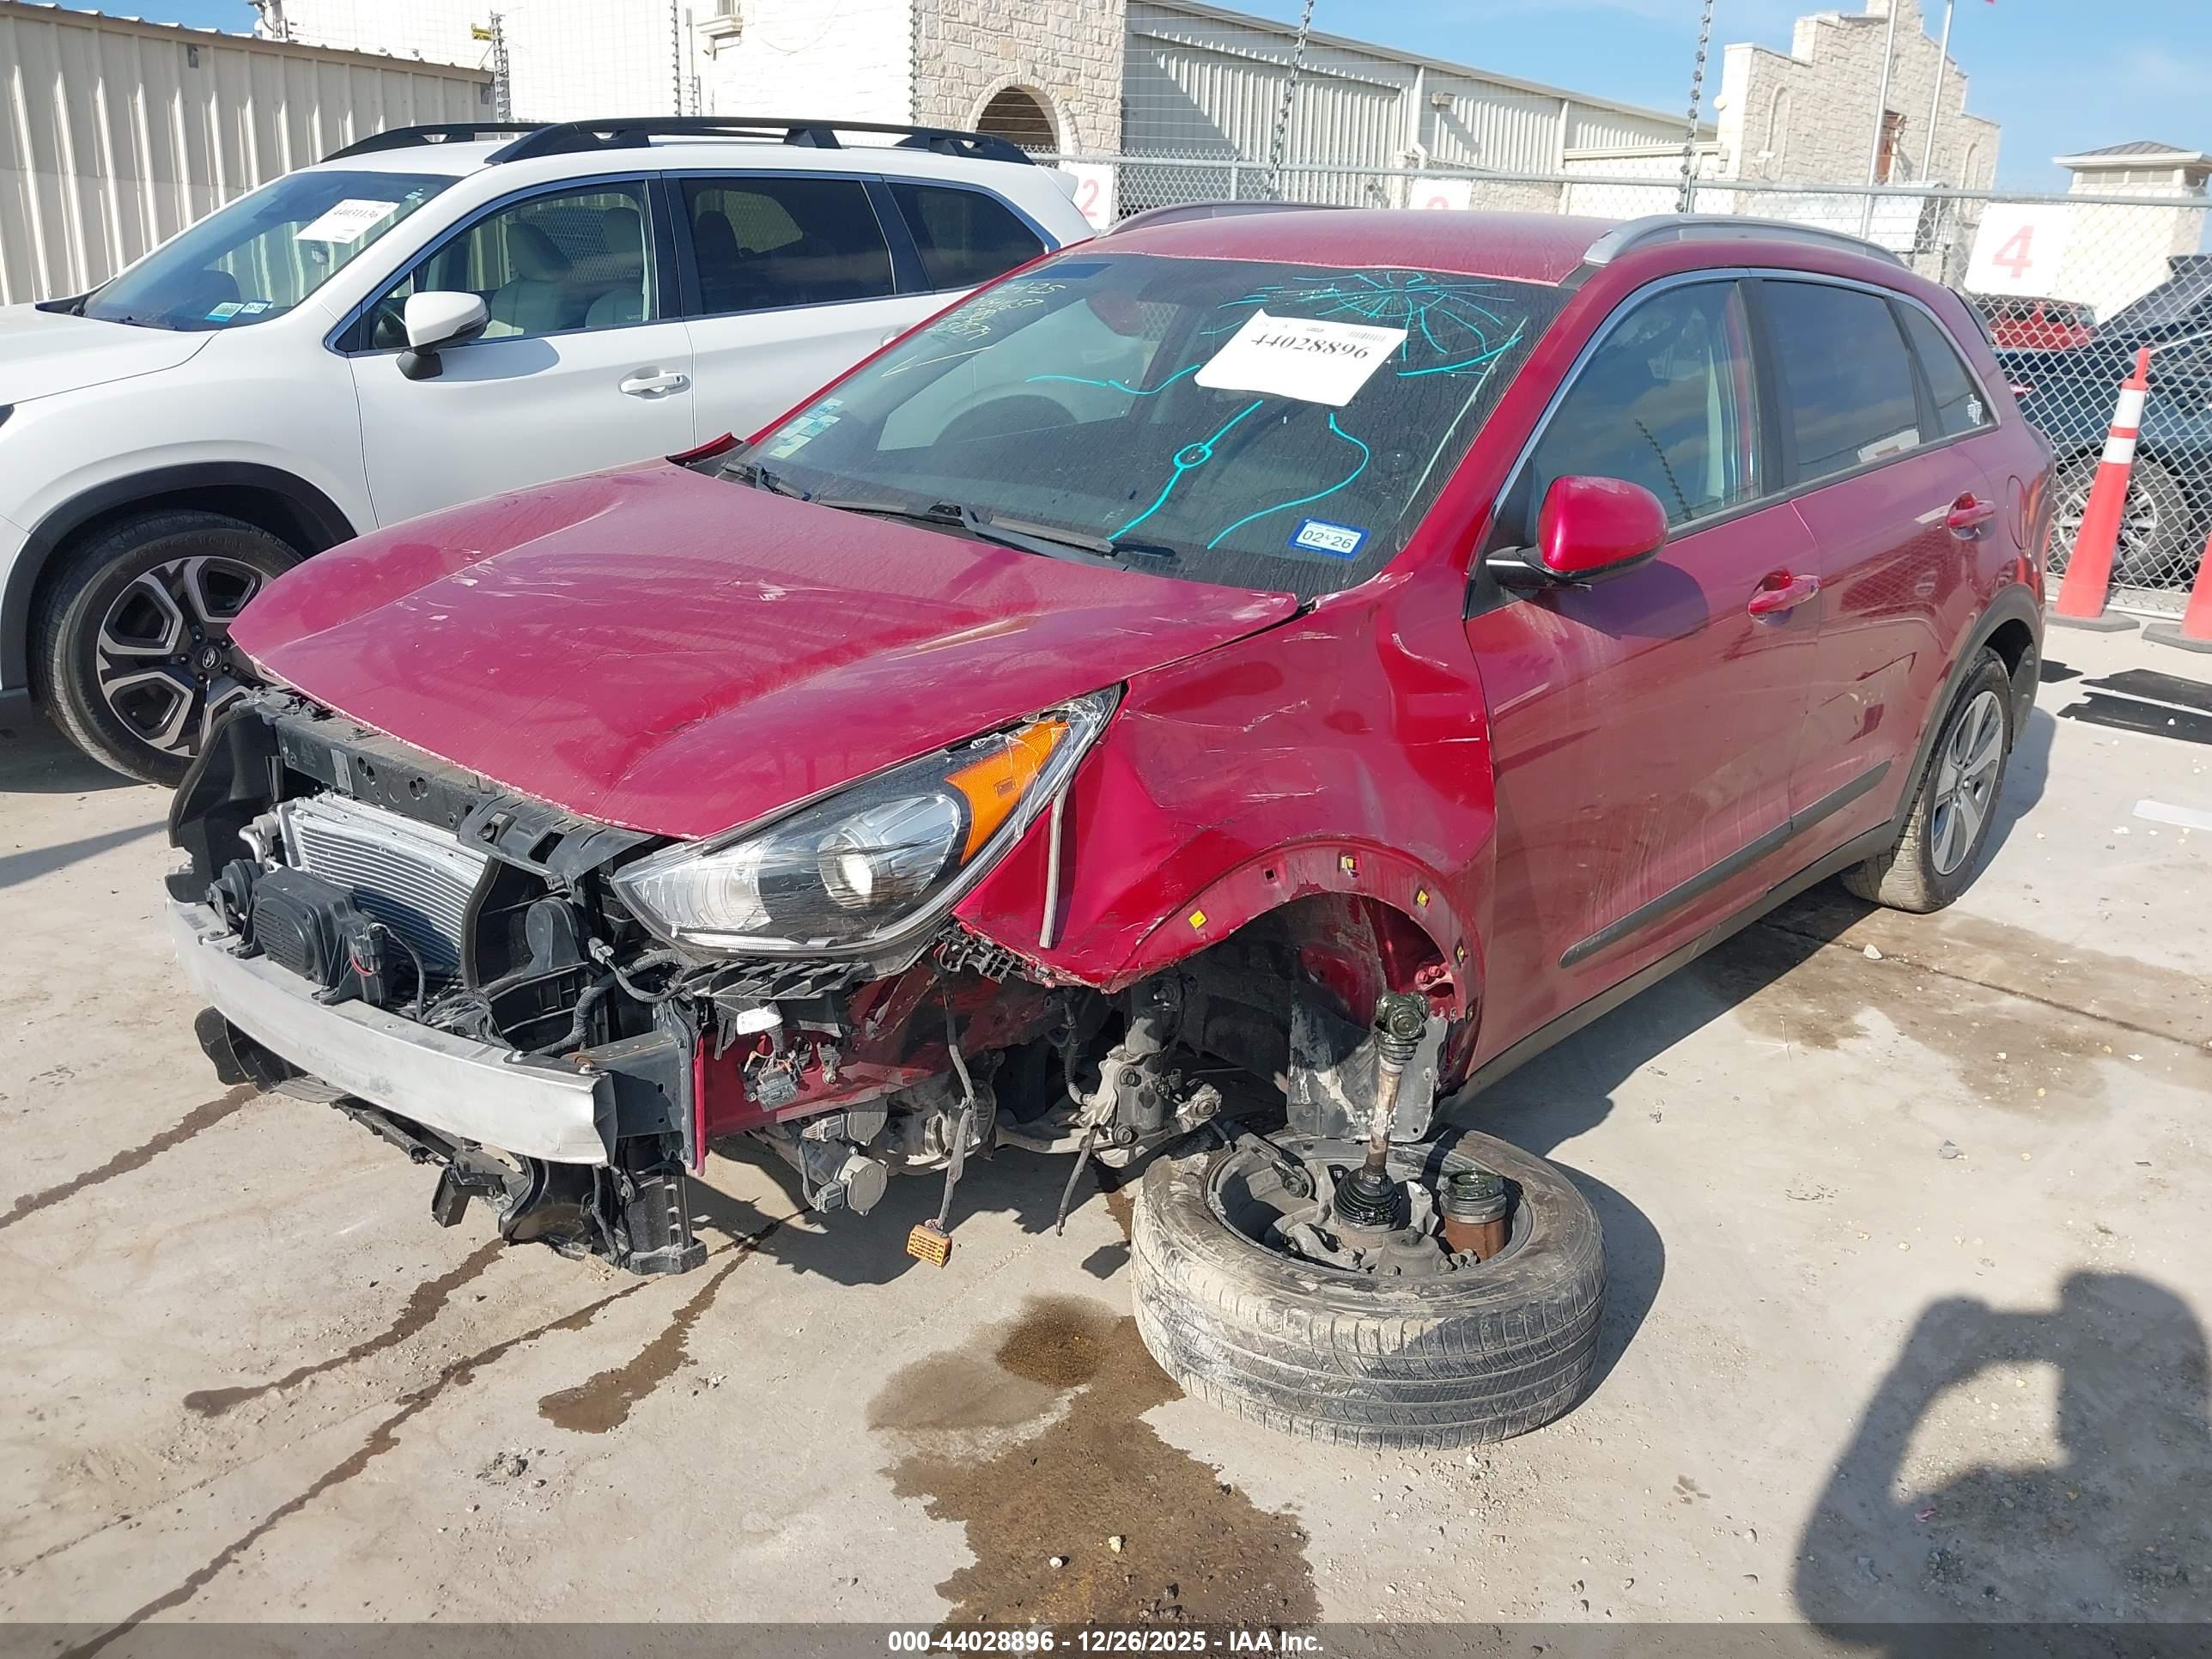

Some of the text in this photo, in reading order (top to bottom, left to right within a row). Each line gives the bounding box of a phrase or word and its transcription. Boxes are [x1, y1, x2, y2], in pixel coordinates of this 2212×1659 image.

[1080, 179, 1099, 217] 2
[1993, 226, 2034, 278] 4
[1251, 332, 1370, 359] 44028896
